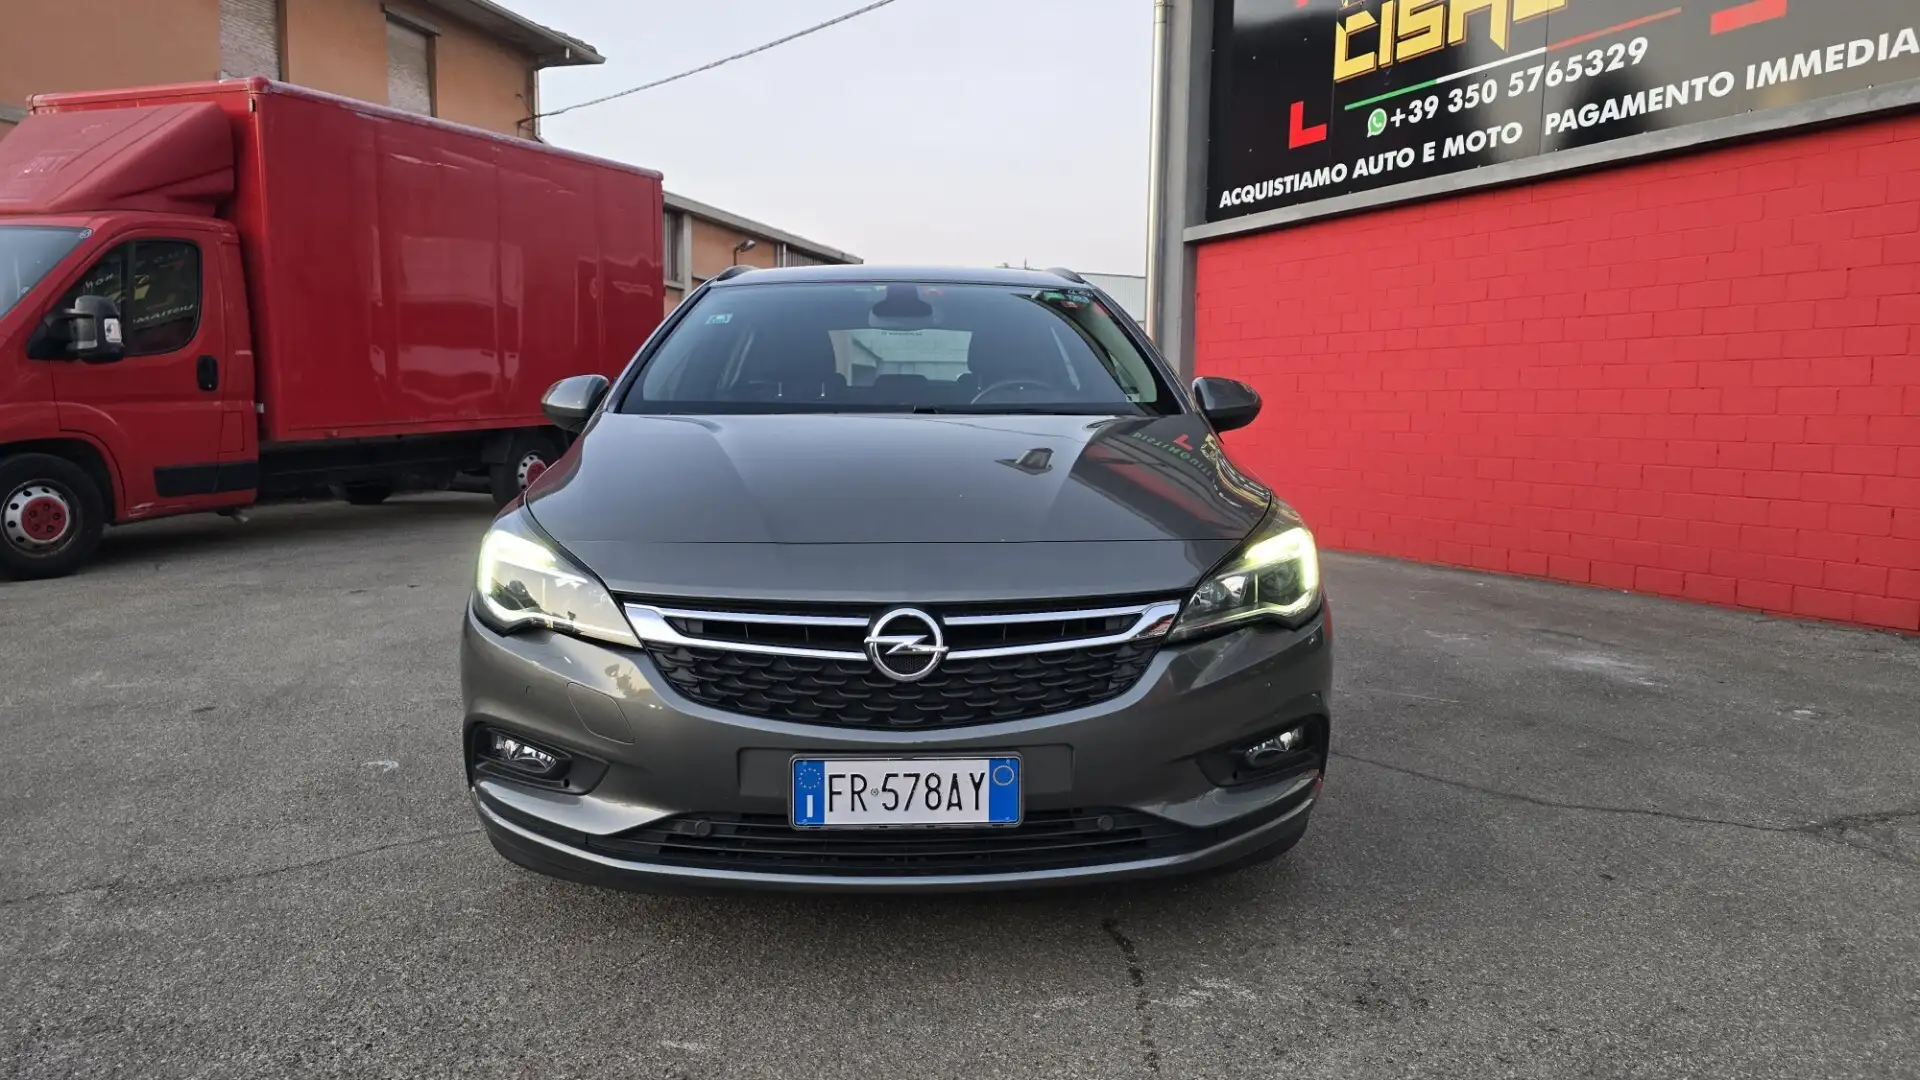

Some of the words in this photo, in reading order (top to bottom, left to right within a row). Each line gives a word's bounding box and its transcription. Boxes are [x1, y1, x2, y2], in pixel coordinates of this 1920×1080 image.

[1390, 95, 1439, 128] +39
[1447, 78, 1498, 114] 350
[1507, 37, 1648, 97] 5765329
[1219, 163, 1348, 208] ACQUISTIAMO
[1352, 147, 1415, 179] AUTO
[1422, 141, 1437, 163] E
[1442, 121, 1523, 159] MOTO
[1545, 71, 1735, 136] PAGAMENTO
[881, 773, 986, 812] 578AY
